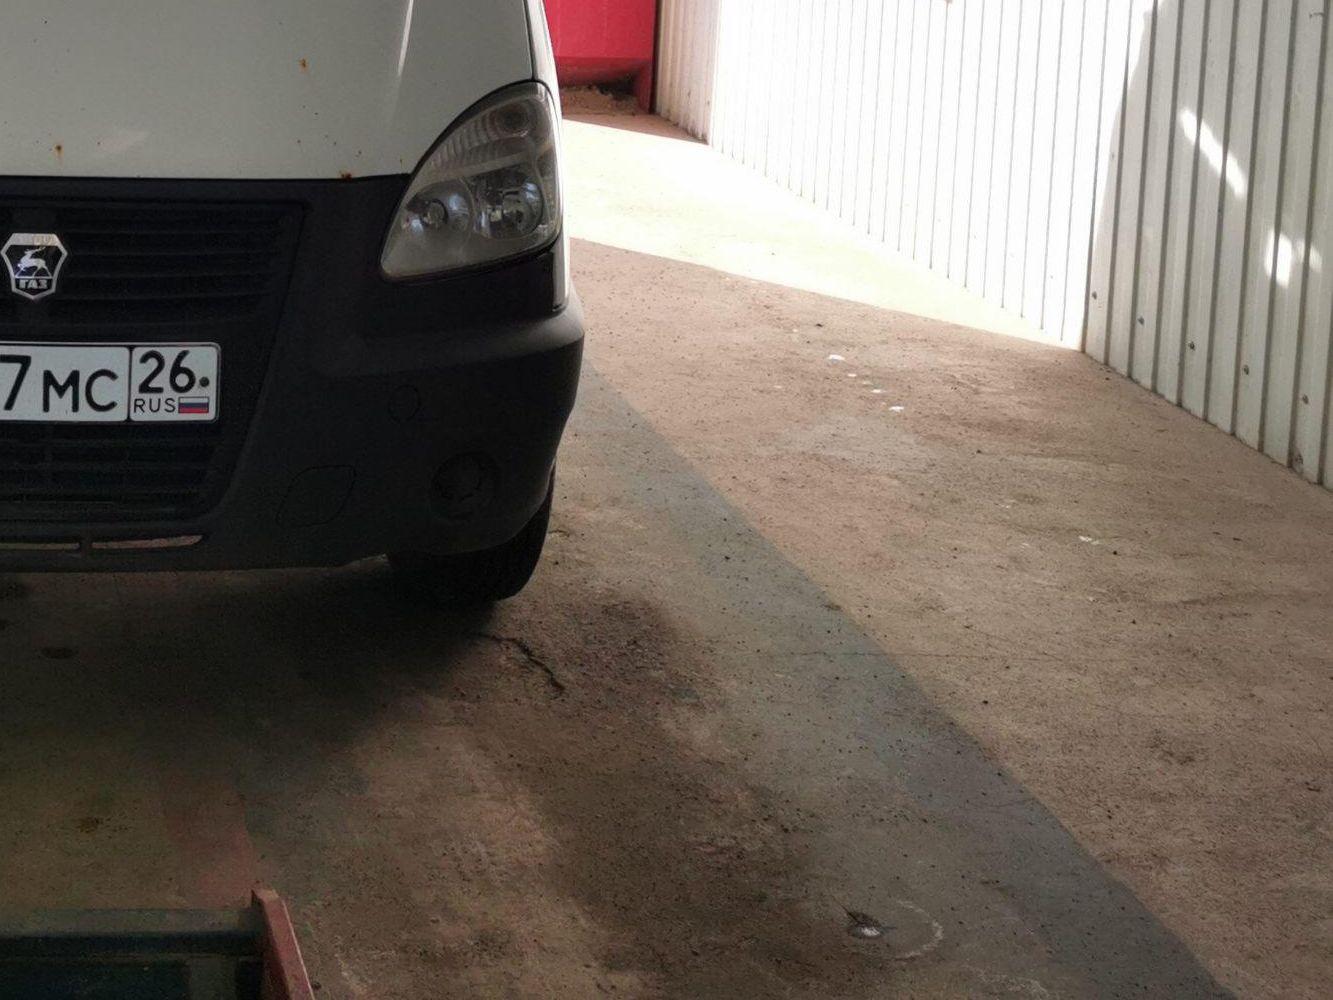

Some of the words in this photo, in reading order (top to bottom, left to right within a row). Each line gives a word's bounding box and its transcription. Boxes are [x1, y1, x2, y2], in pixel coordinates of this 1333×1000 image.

[19, 279, 48, 289] ГАЗ
[138, 349, 197, 395] 26
[133, 397, 176, 414] RUS
